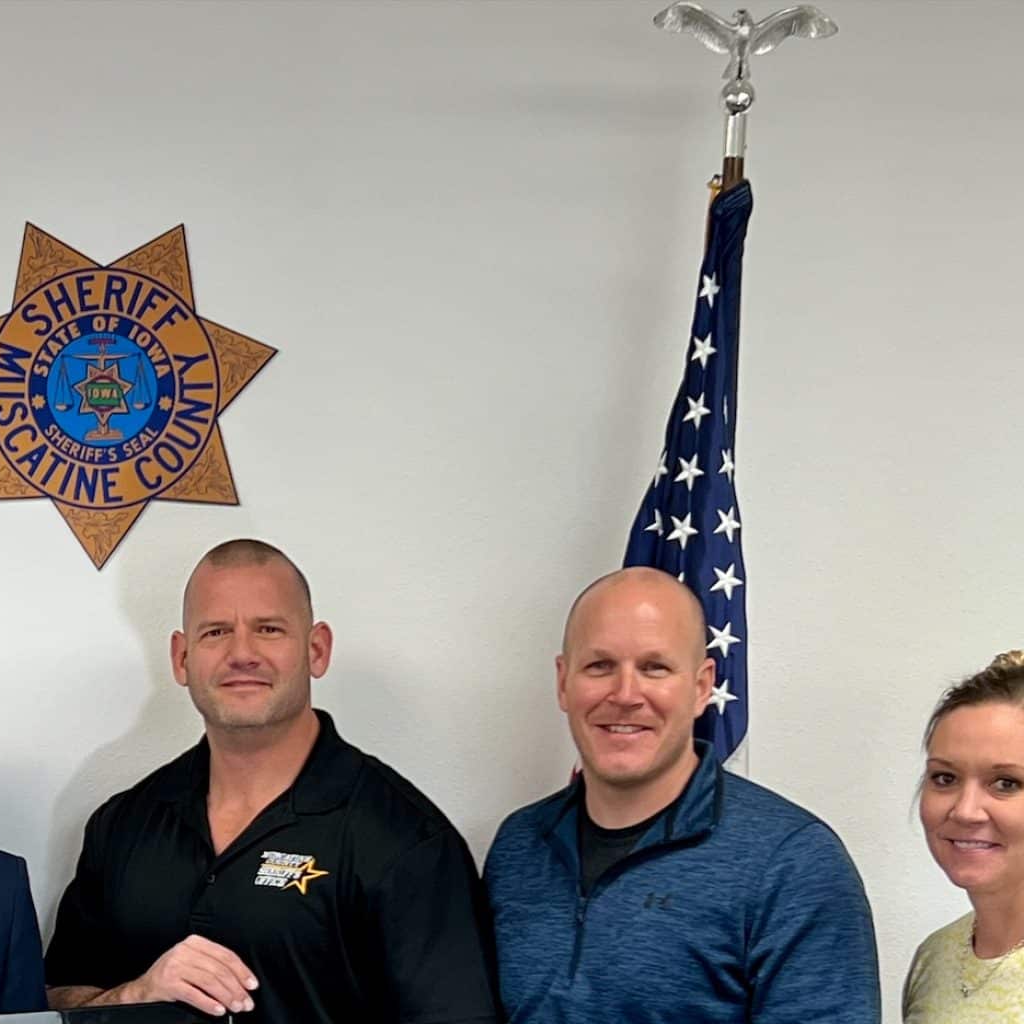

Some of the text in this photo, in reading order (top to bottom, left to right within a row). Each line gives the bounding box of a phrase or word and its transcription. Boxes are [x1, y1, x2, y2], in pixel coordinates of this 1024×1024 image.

[22, 275, 188, 337] SHERIFF
[33, 315, 171, 379] STATE OF IOWA
[87, 387, 119, 399] IOWA
[133, 352, 214, 491] COUNTY
[44, 423, 160, 462] SHERIFF'S SEAL
